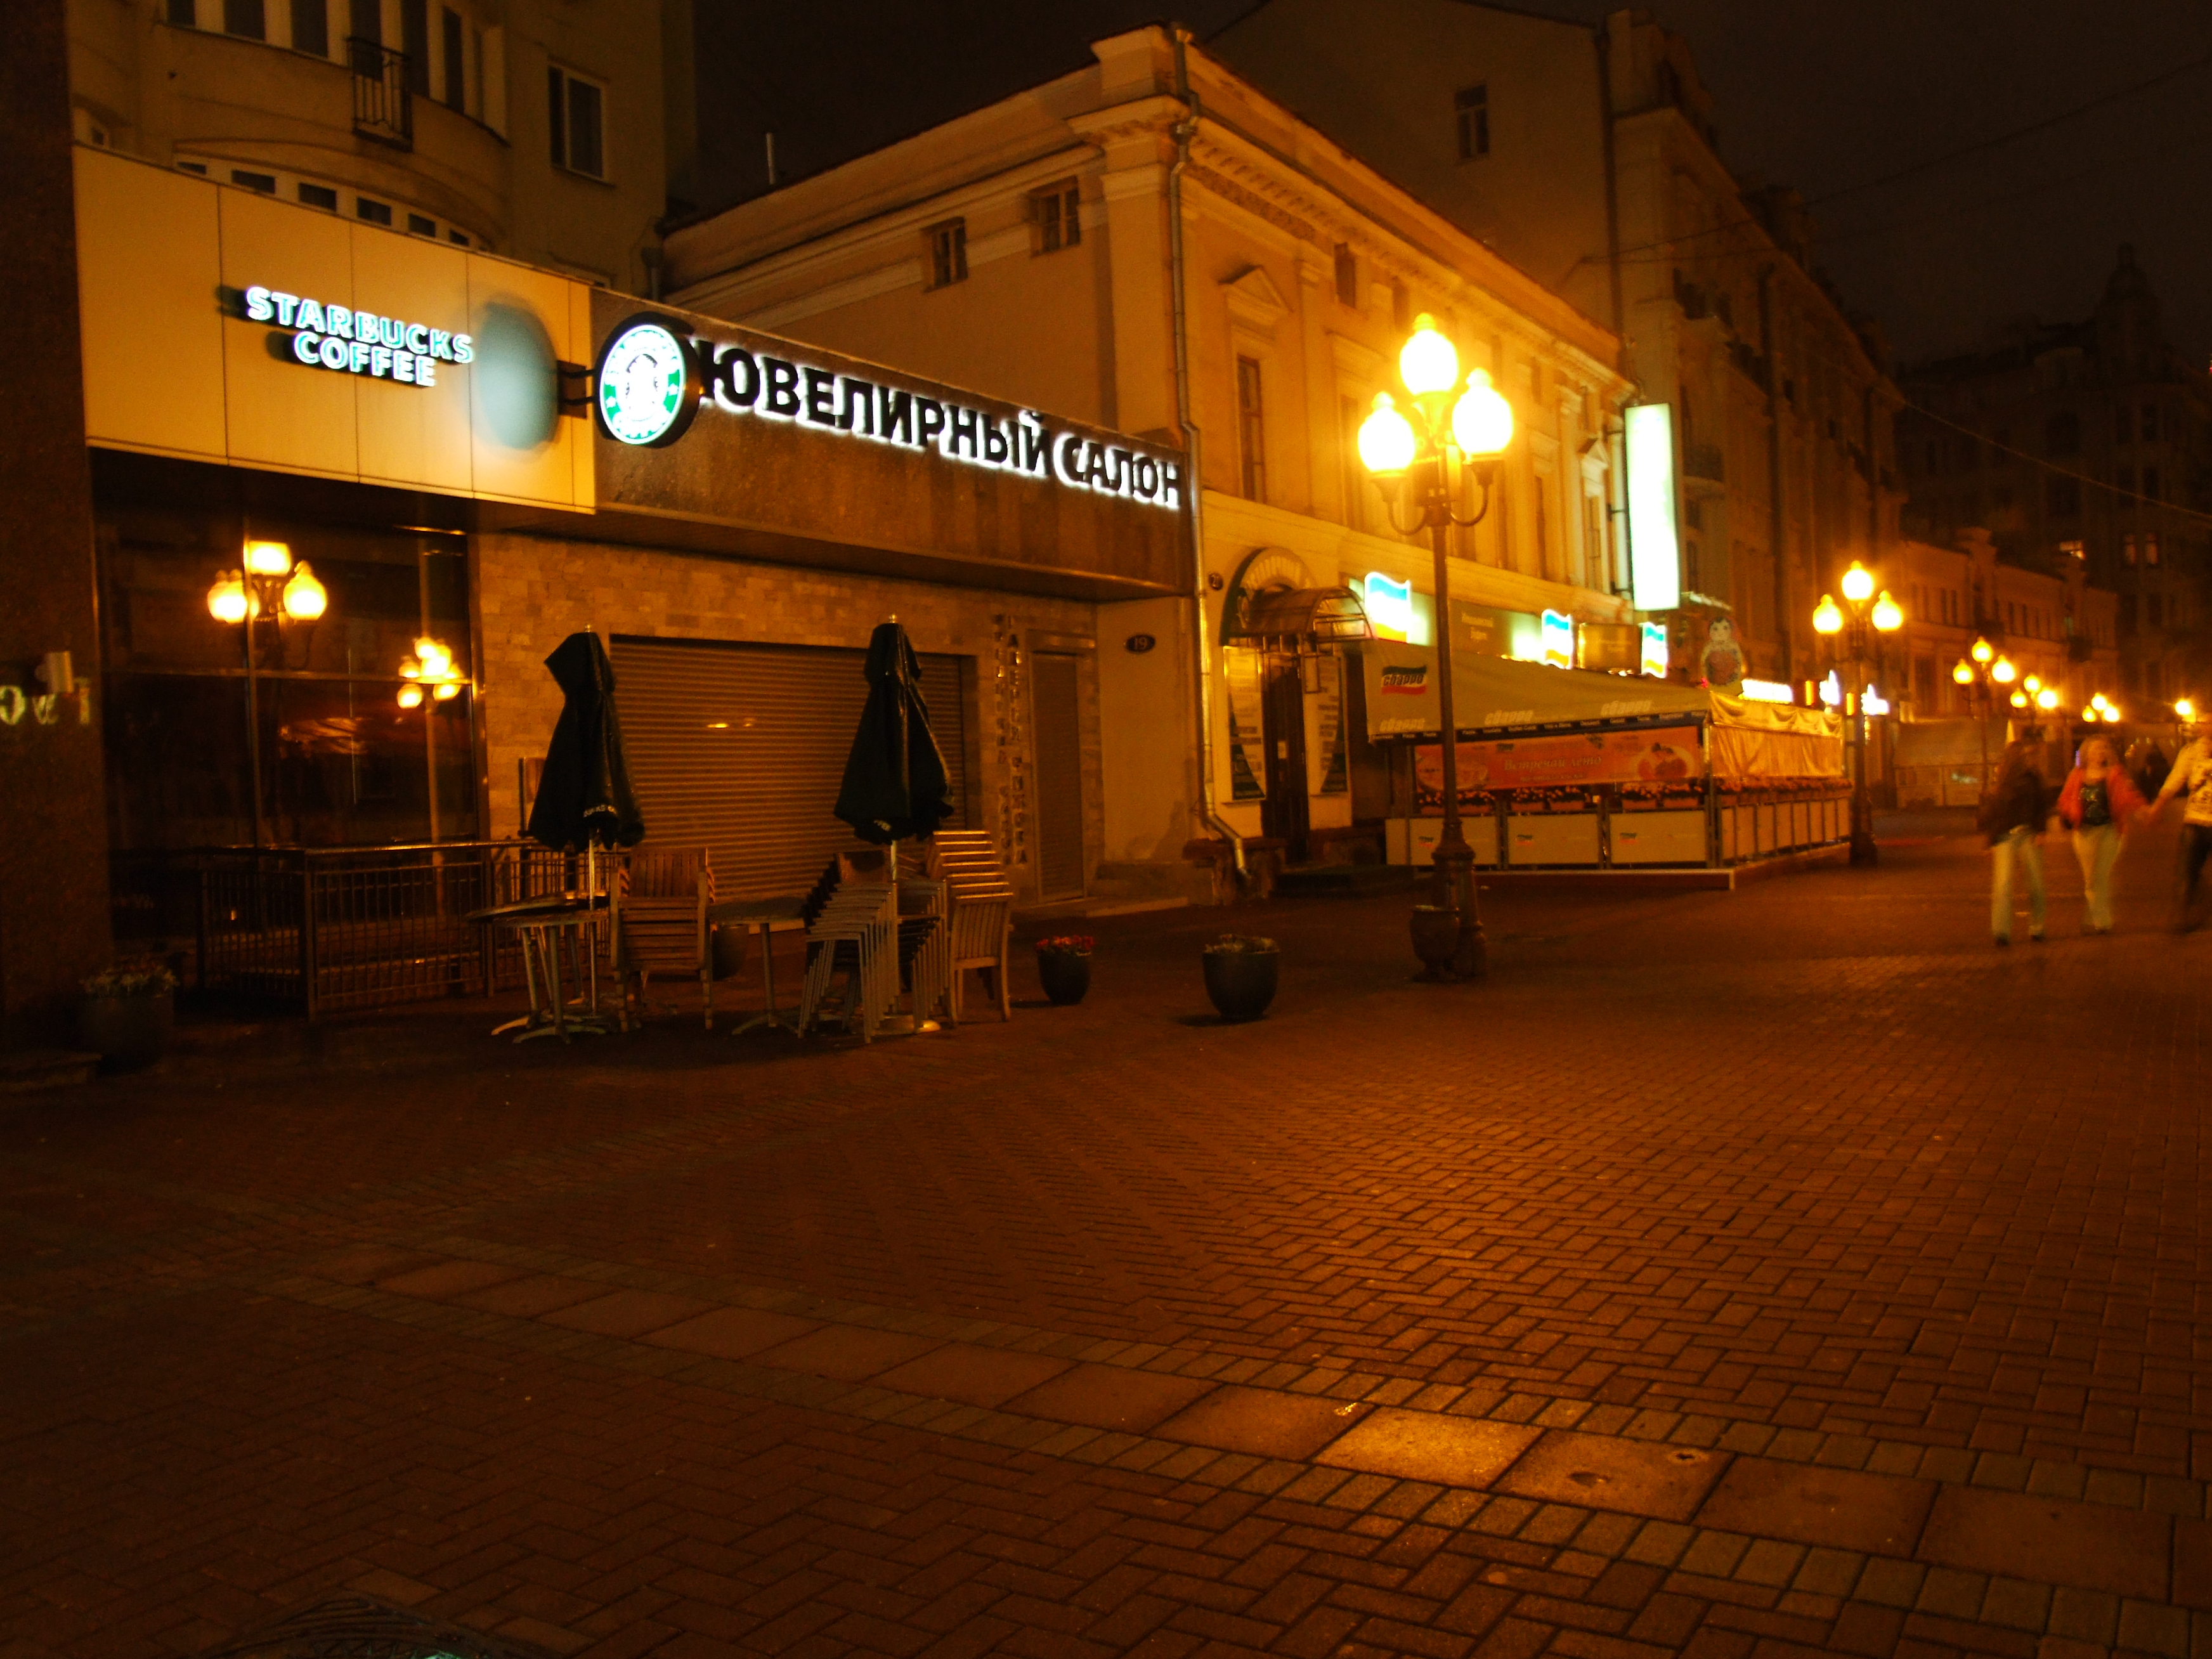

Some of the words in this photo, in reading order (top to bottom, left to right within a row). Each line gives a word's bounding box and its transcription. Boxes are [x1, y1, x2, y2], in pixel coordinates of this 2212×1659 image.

[246, 286, 475, 364] STARBUCKS
[294, 330, 438, 387] COFFEE
[698, 339, 1052, 477] ЮВЕЛИРНЫЙ
[1056, 434, 1181, 507] САЛОН
